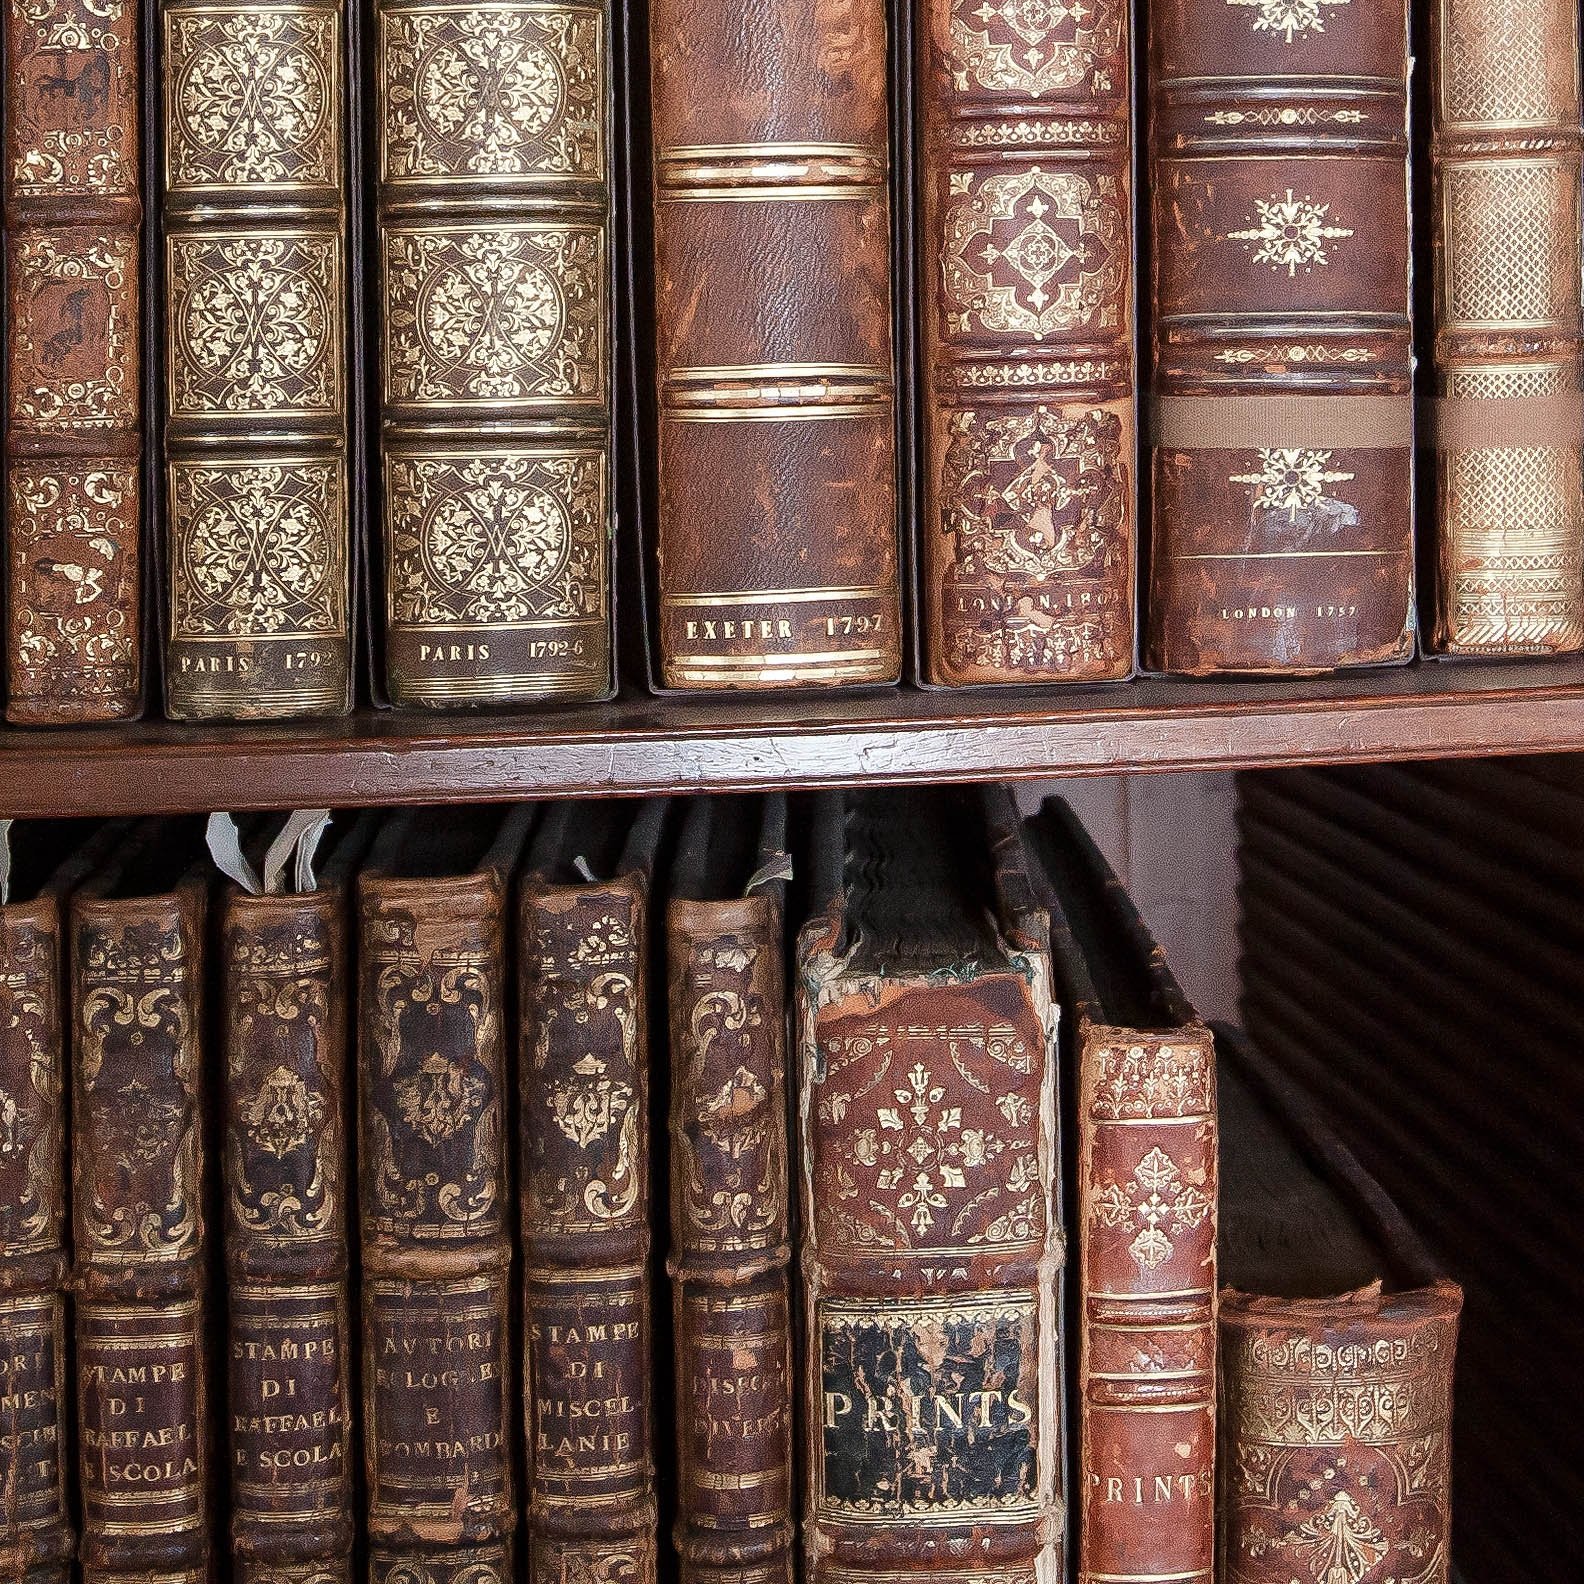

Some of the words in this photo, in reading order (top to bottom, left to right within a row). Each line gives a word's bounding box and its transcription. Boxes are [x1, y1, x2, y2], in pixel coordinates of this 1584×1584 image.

[1222, 608, 1296, 618] LONDON
[1317, 606, 1356, 616] 1757
[686, 620, 791, 639] EXETER
[826, 616, 882, 634] 1797
[420, 644, 490, 661] PARIS
[529, 641, 584, 658] 1792-6
[180, 656, 249, 672] PARIS
[531, 1323, 638, 1342] STAMPE
[233, 1340, 334, 1360] STAMPE
[566, 1362, 603, 1378] DI
[262, 1380, 296, 1399] DI
[108, 1397, 144, 1415] DI
[826, 1388, 1030, 1433] PRINTS
[260, 1444, 342, 1467] SCOLA
[109, 1457, 198, 1482] SCOLA
